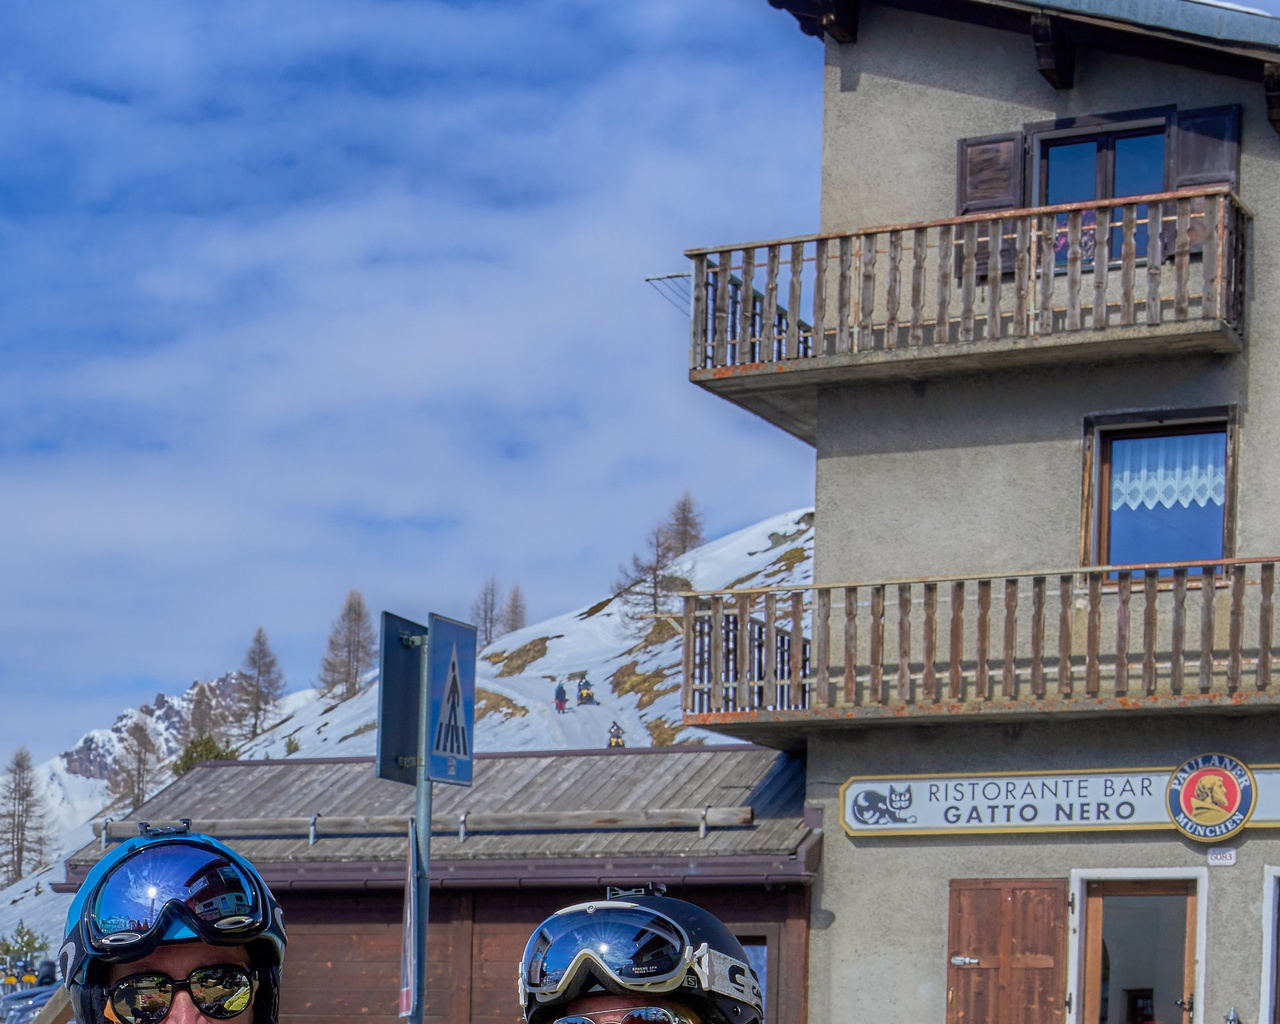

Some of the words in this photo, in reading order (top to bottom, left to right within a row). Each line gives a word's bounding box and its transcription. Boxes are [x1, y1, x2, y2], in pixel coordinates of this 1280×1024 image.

[1170, 755, 1250, 792] PAULANER
[928, 779, 1089, 802] RISTORANTE
[1104, 777, 1153, 798] BAR
[943, 803, 1039, 824] GATTO
[1055, 801, 1136, 821] NERO
[1175, 811, 1245, 837] MÜNCHEN
